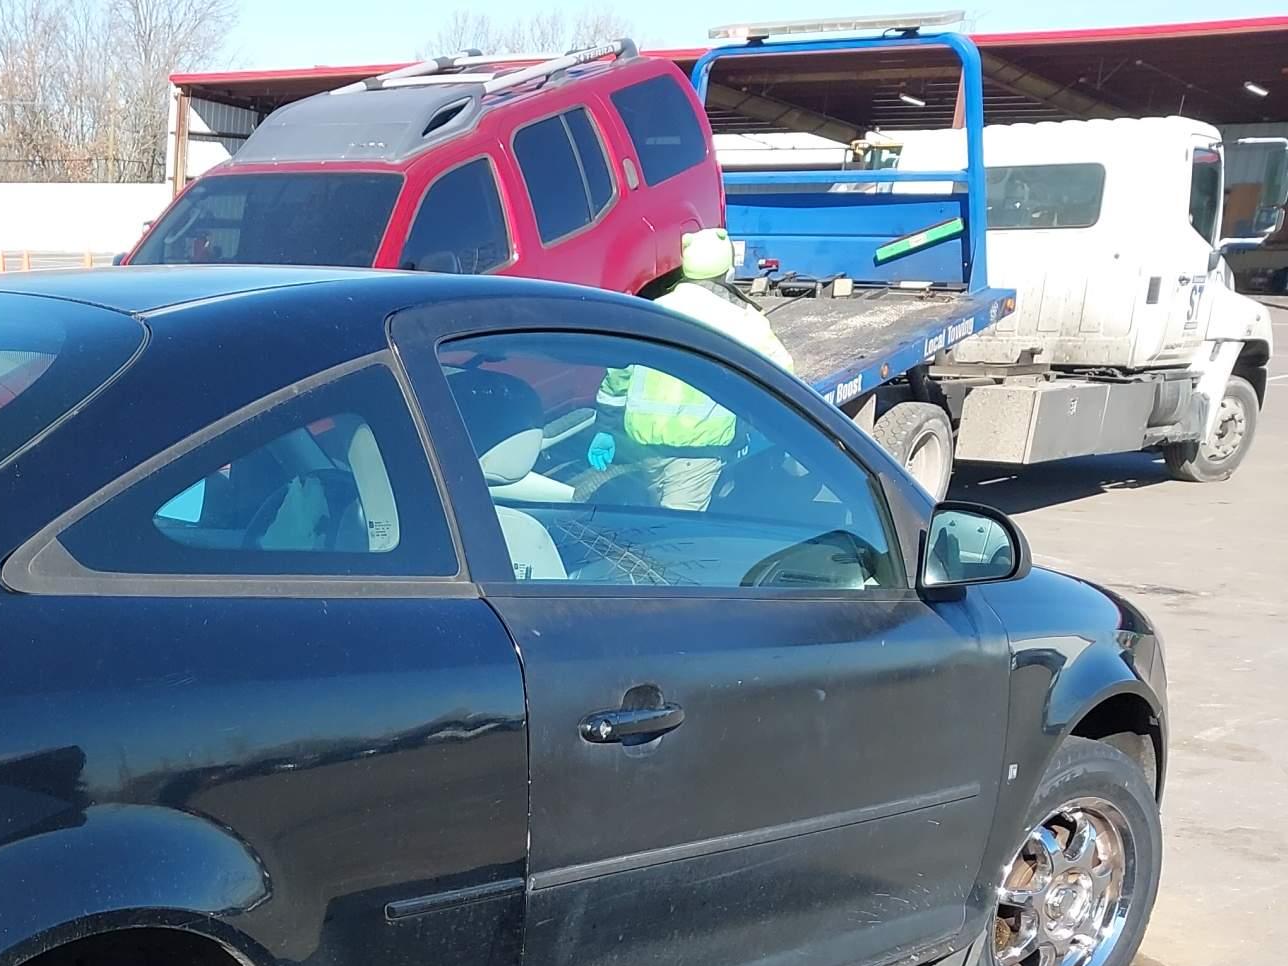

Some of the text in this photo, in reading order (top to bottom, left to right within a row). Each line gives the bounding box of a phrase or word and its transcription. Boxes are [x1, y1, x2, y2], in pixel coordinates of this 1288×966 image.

[923, 316, 975, 358] Local Towing
[836, 373, 863, 404] Boost
